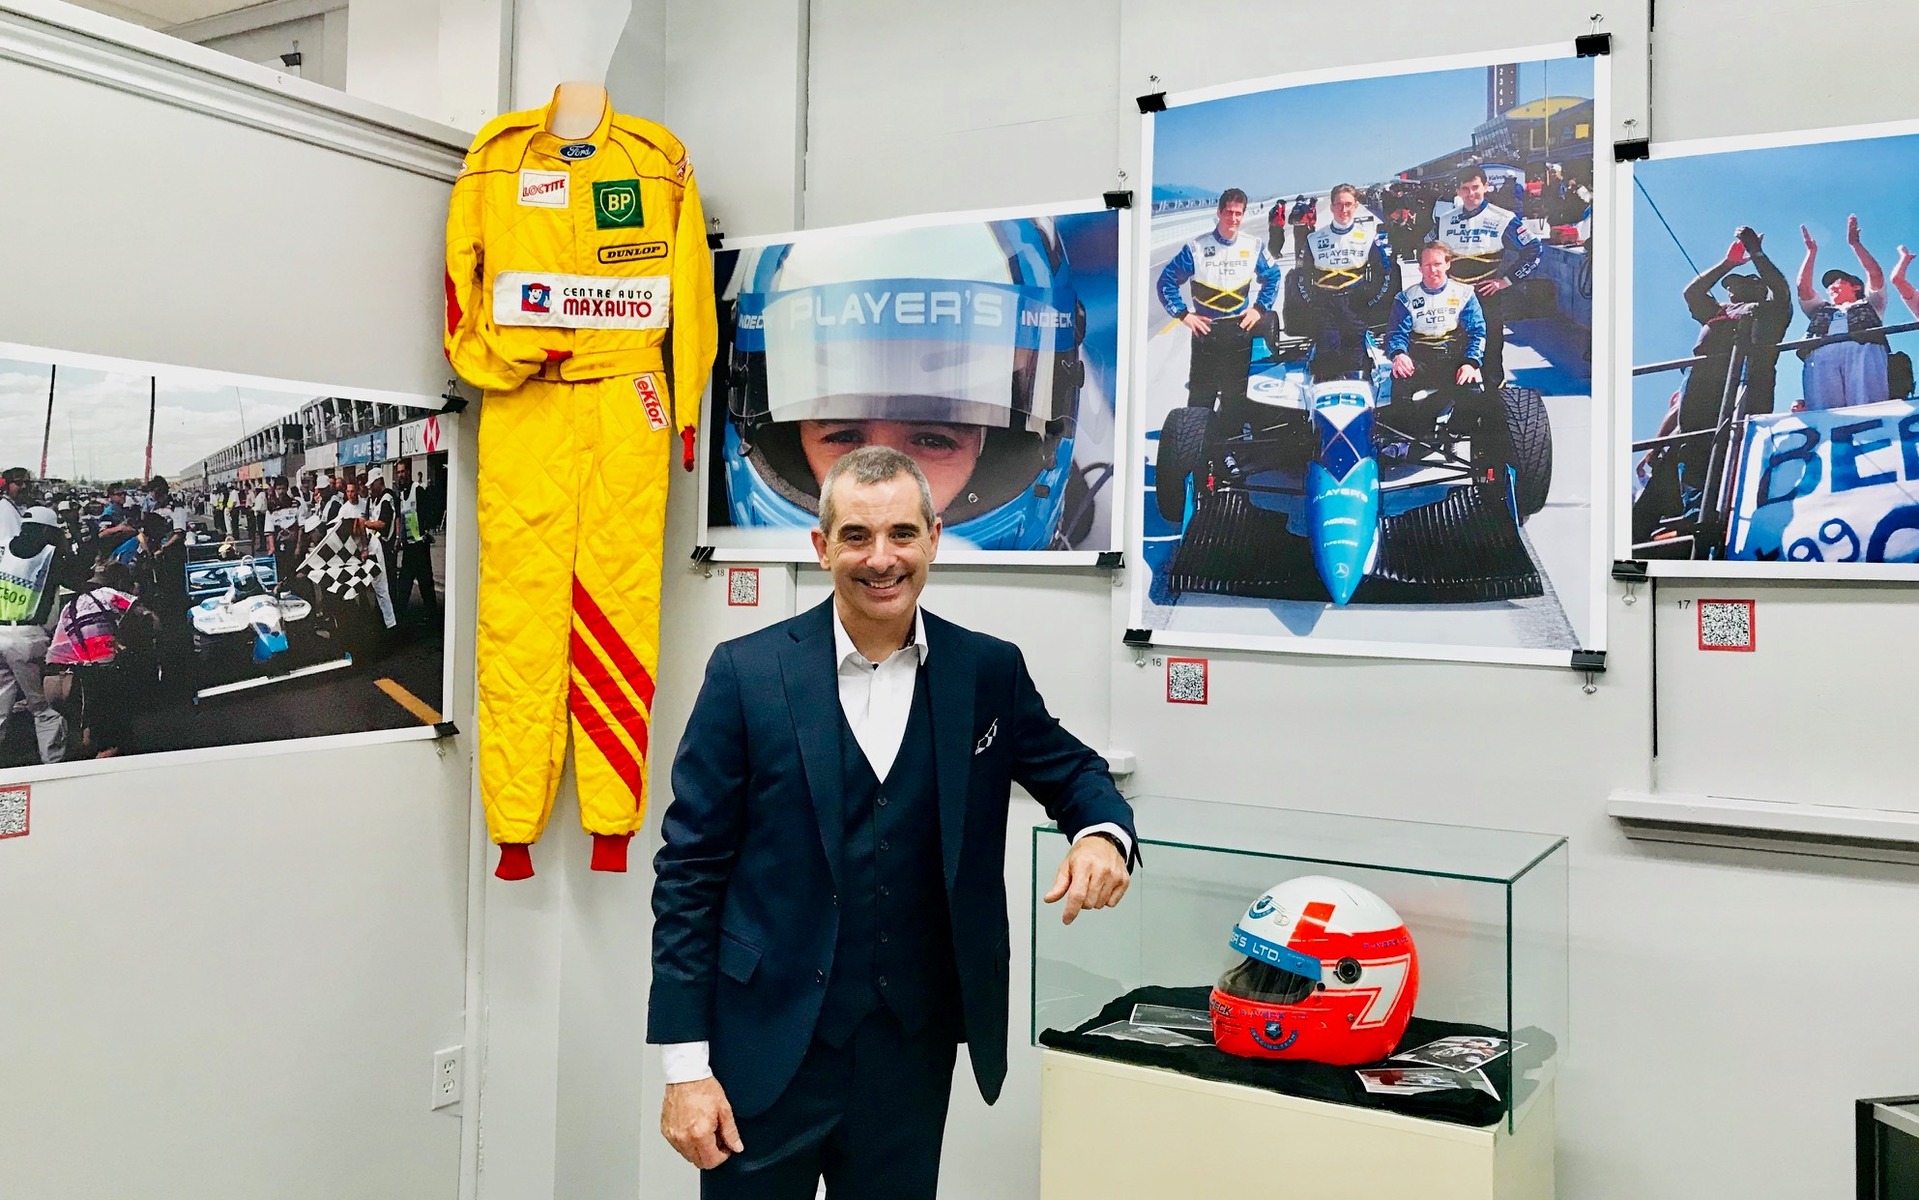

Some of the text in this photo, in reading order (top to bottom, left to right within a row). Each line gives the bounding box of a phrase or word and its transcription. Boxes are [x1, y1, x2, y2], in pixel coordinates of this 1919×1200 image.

[566, 145, 591, 156] Ford
[522, 178, 566, 198] LOCTITE
[608, 193, 631, 212] BP
[606, 246, 661, 259] DUNLOP
[563, 287, 653, 300] CENTRE AUTO
[563, 298, 652, 318] MAXAUTO
[789, 289, 1003, 331] PLAYER'S
[1021, 310, 1073, 328] INDECK
[717, 569, 725, 577] 18
[1678, 600, 1691, 610] 17
[1152, 658, 1162, 667] 16
[1252, 942, 1280, 963] LTD.
